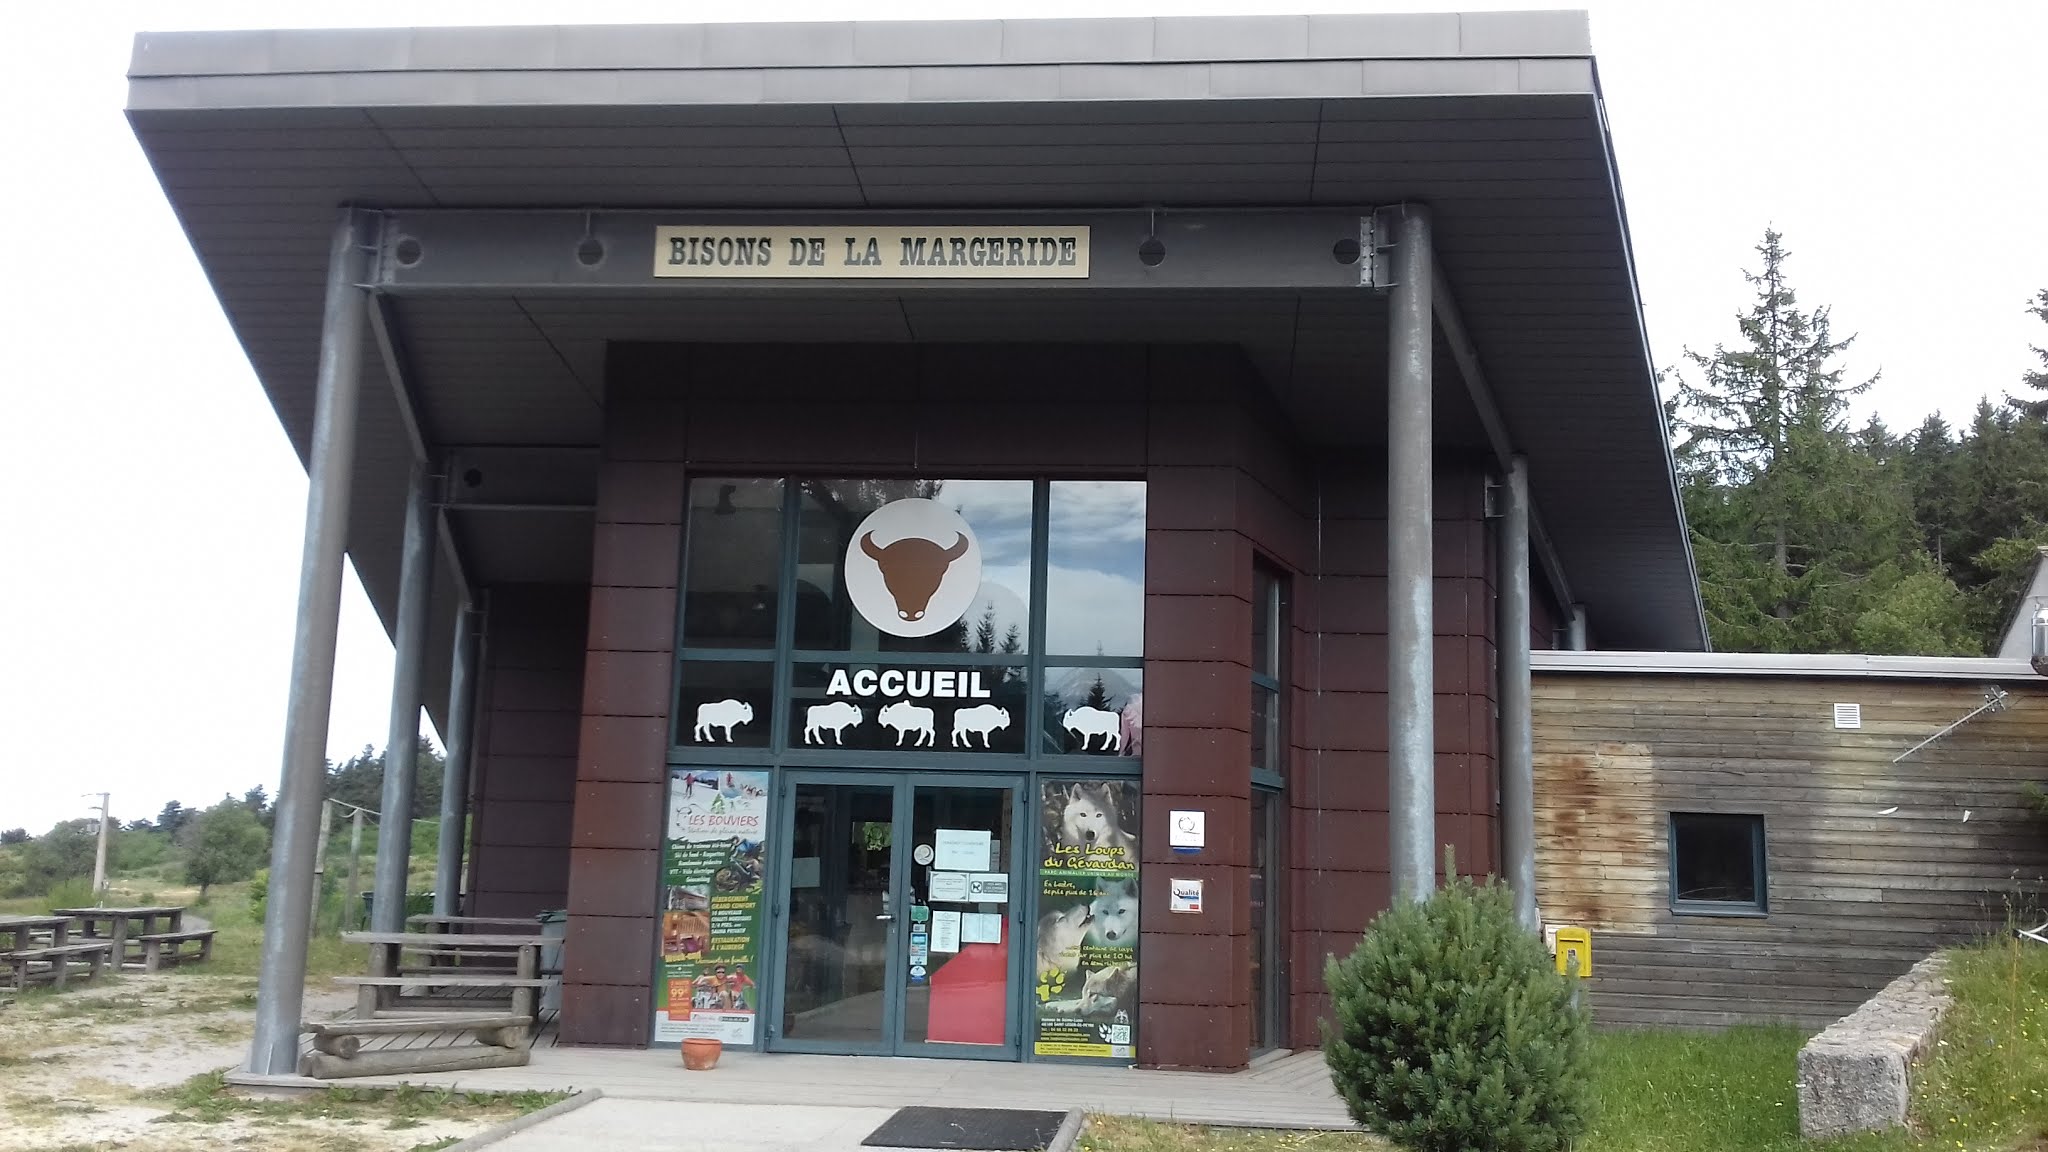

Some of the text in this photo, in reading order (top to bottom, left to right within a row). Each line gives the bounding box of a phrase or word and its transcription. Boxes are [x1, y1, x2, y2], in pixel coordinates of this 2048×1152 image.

[668, 236, 1077, 267] BISONS DE LA MARGERIDE
[826, 669, 991, 698] ACCUEIL
[688, 815, 759, 827] LES BOUVIERS
[1055, 842, 1125, 857] Les Loups
[1044, 856, 1135, 869] du Gévaudan
[1173, 888, 1199, 899] Qualité
